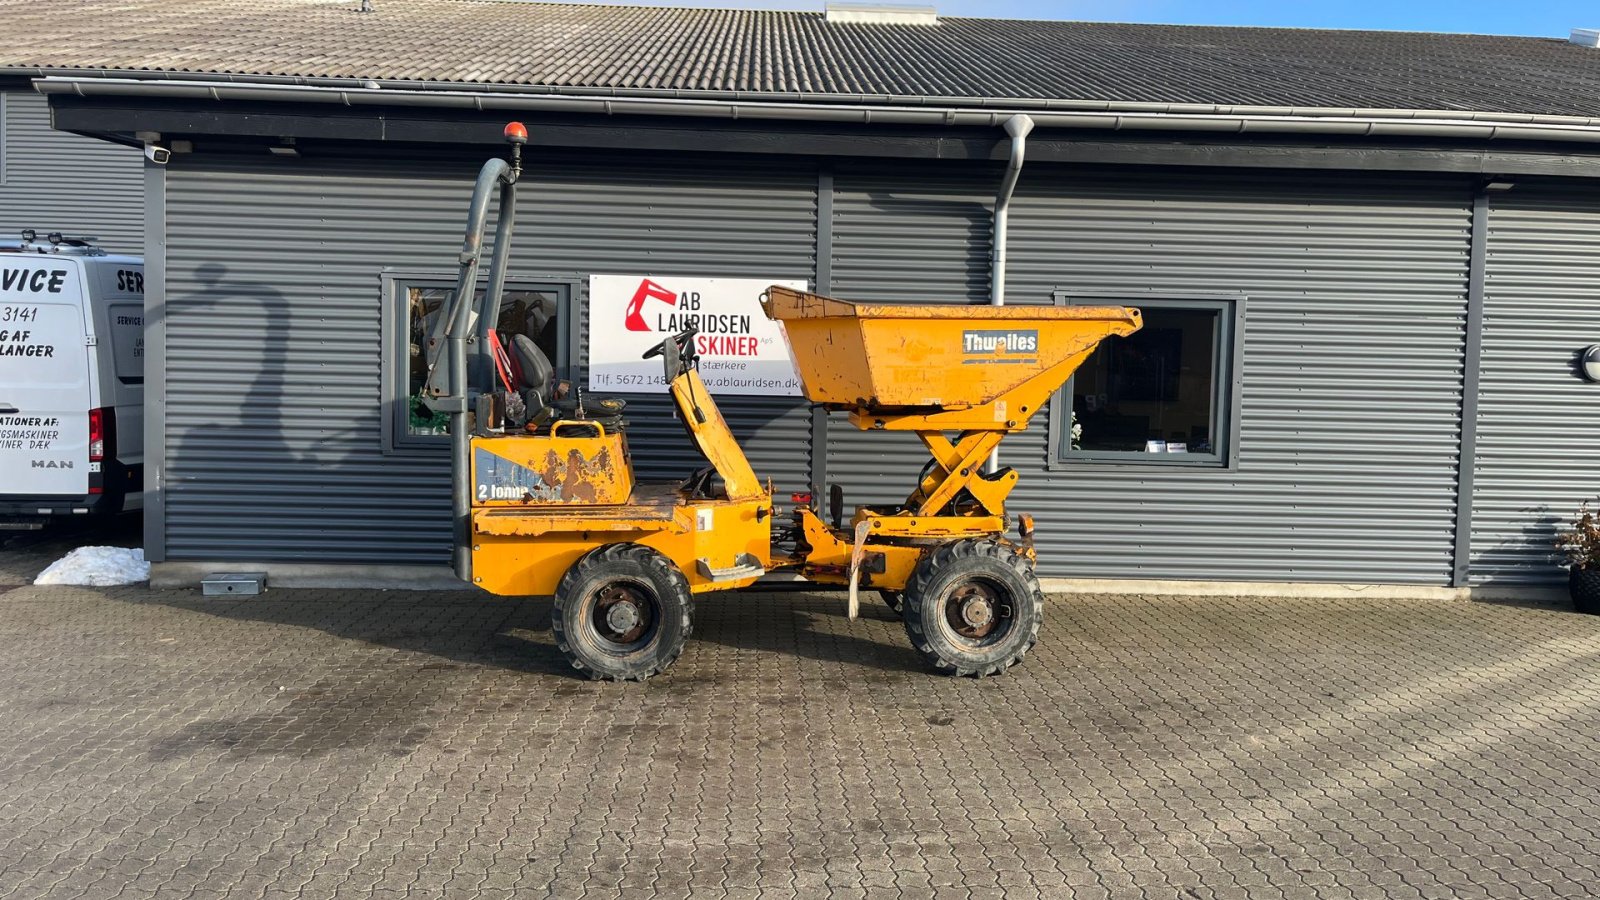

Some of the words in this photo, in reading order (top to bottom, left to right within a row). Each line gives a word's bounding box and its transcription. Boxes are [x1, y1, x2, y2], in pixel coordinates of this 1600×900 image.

[679, 292, 701, 311] AB
[2, 306, 38, 322] 3141
[117, 315, 141, 326] SERVICE
[658, 313, 750, 333] LAURIDSEN
[12, 330, 31, 342] AF
[964, 333, 1036, 350] Thwaites
[691, 335, 758, 356] SKINER
[702, 361, 747, 370] stærkere
[595, 374, 613, 386] Tlf.
[616, 374, 643, 385] 5672
[646, 375, 667, 386] 148
[702, 377, 799, 389] w.ablauridsen.dk
[0, 429, 59, 440] GSMASKINER
[29, 440, 51, 450] DÆK
[31, 460, 74, 469] MAN
[478, 484, 488, 499] 2
